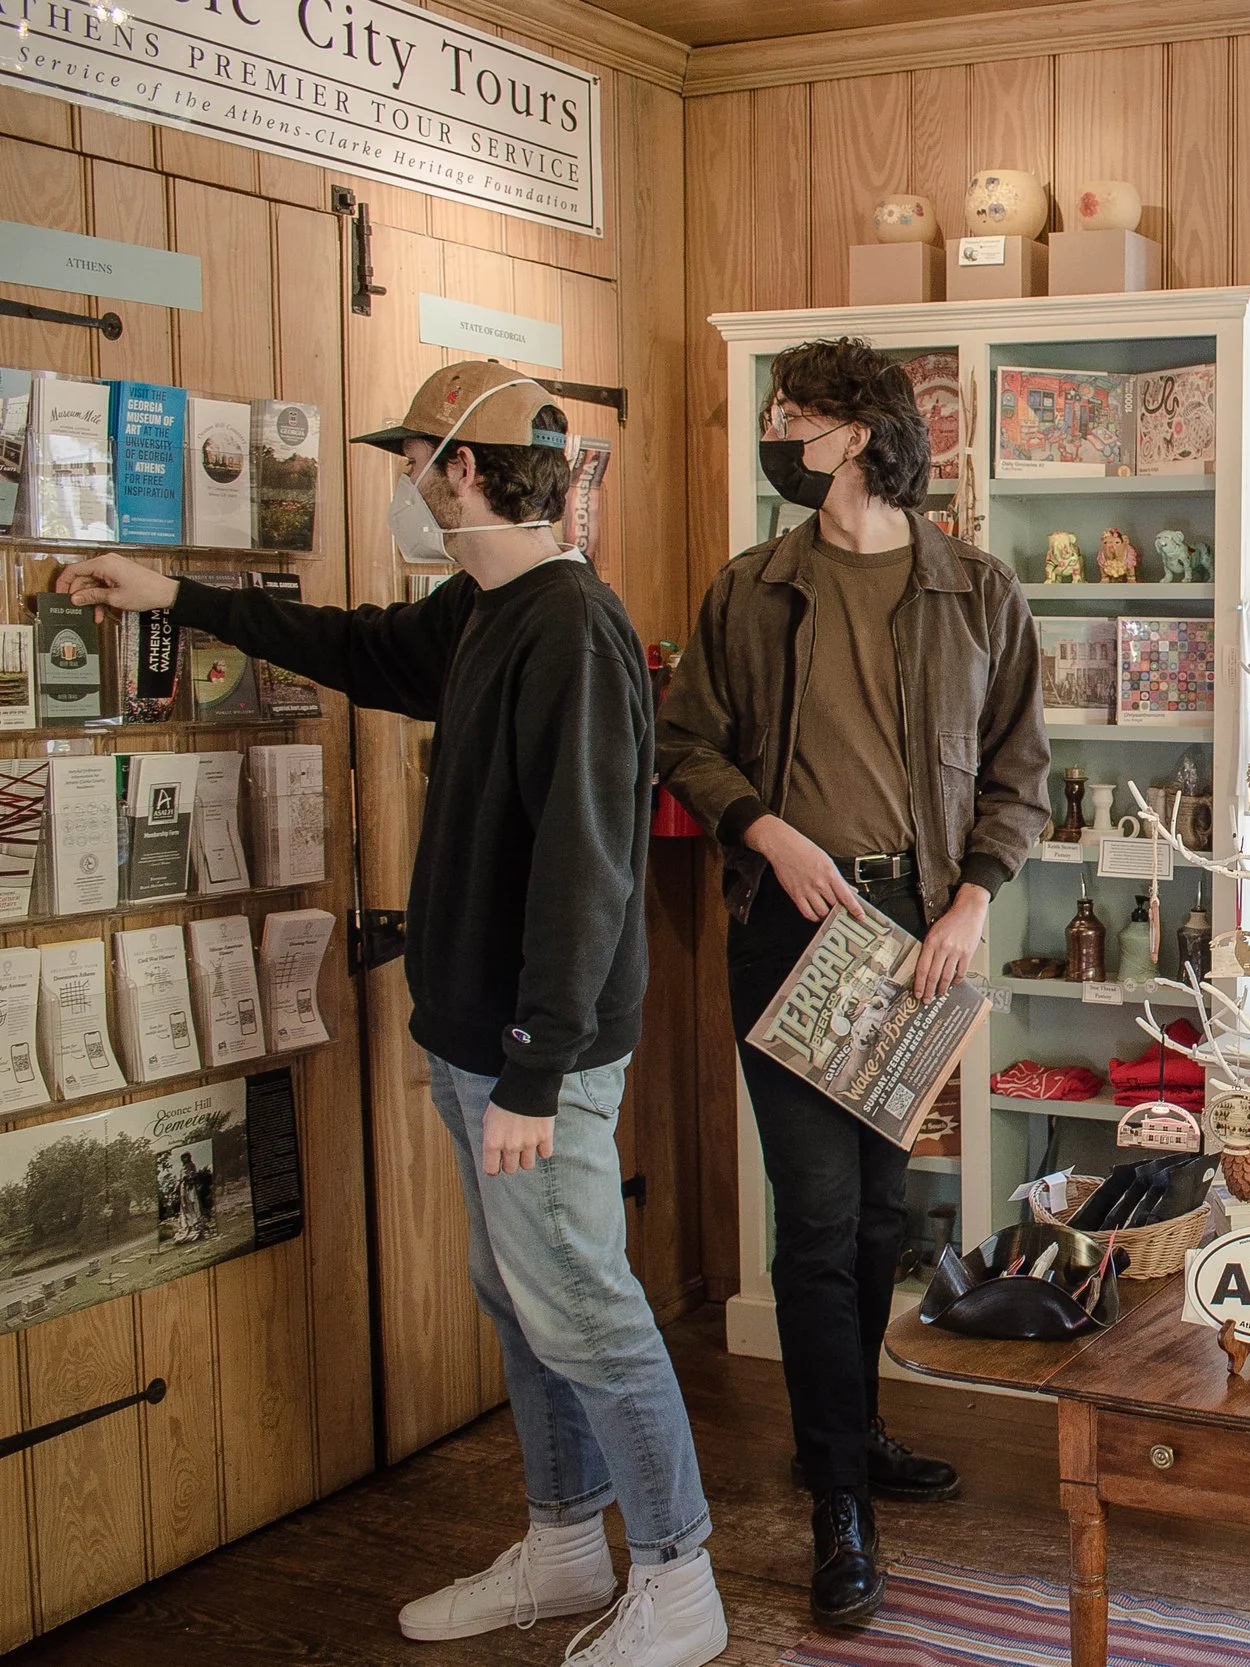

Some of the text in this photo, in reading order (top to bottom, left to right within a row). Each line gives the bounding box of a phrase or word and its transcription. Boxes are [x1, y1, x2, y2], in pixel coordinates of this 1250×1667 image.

[297, 0, 578, 132] City Tours
[188, 44, 351, 115] PREMIER
[371, 100, 453, 145] TOUR
[471, 132, 580, 183] SERVICE
[17, 46, 579, 214] Service of the Athens-Clarke Heritage Foundation
[66, 256, 113, 276] ATHENS
[459, 320, 526, 344] STATE OF GEORGIA
[129, 387, 167, 400] VISIT THE
[1124, 393, 1134, 414] 1000
[50, 407, 82, 423] Museum
[127, 400, 164, 413] GEORGIA
[126, 412, 175, 427] MUSEUM OF
[125, 424, 170, 438] ART AT THE
[126, 436, 174, 450] UNIVERSITY
[126, 448, 174, 462] OF GEORGIA
[125, 461, 166, 474] IN ATHENS
[125, 473, 164, 486] FOR FREE
[125, 486, 176, 499] INSPIRATION
[49, 607, 83, 616] FIELD GUIDE
[149, 626, 161, 672] ATHENS
[160, 637, 172, 673] WALK
[763, 909, 892, 1063] TERRAPIN
[811, 1010, 831, 1046] BEER
[837, 994, 920, 1100] Wake-n-Bake
[884, 1026, 919, 1073] FEBRUARY
[907, 1029, 925, 1051] BEER
[824, 1044, 851, 1082] GIVING
[883, 1050, 913, 1092] TERRAPIN
[878, 1087, 891, 1106] AT
[157, 1097, 212, 1120] Oconee Hill
[152, 1109, 223, 1137] Cemetery
